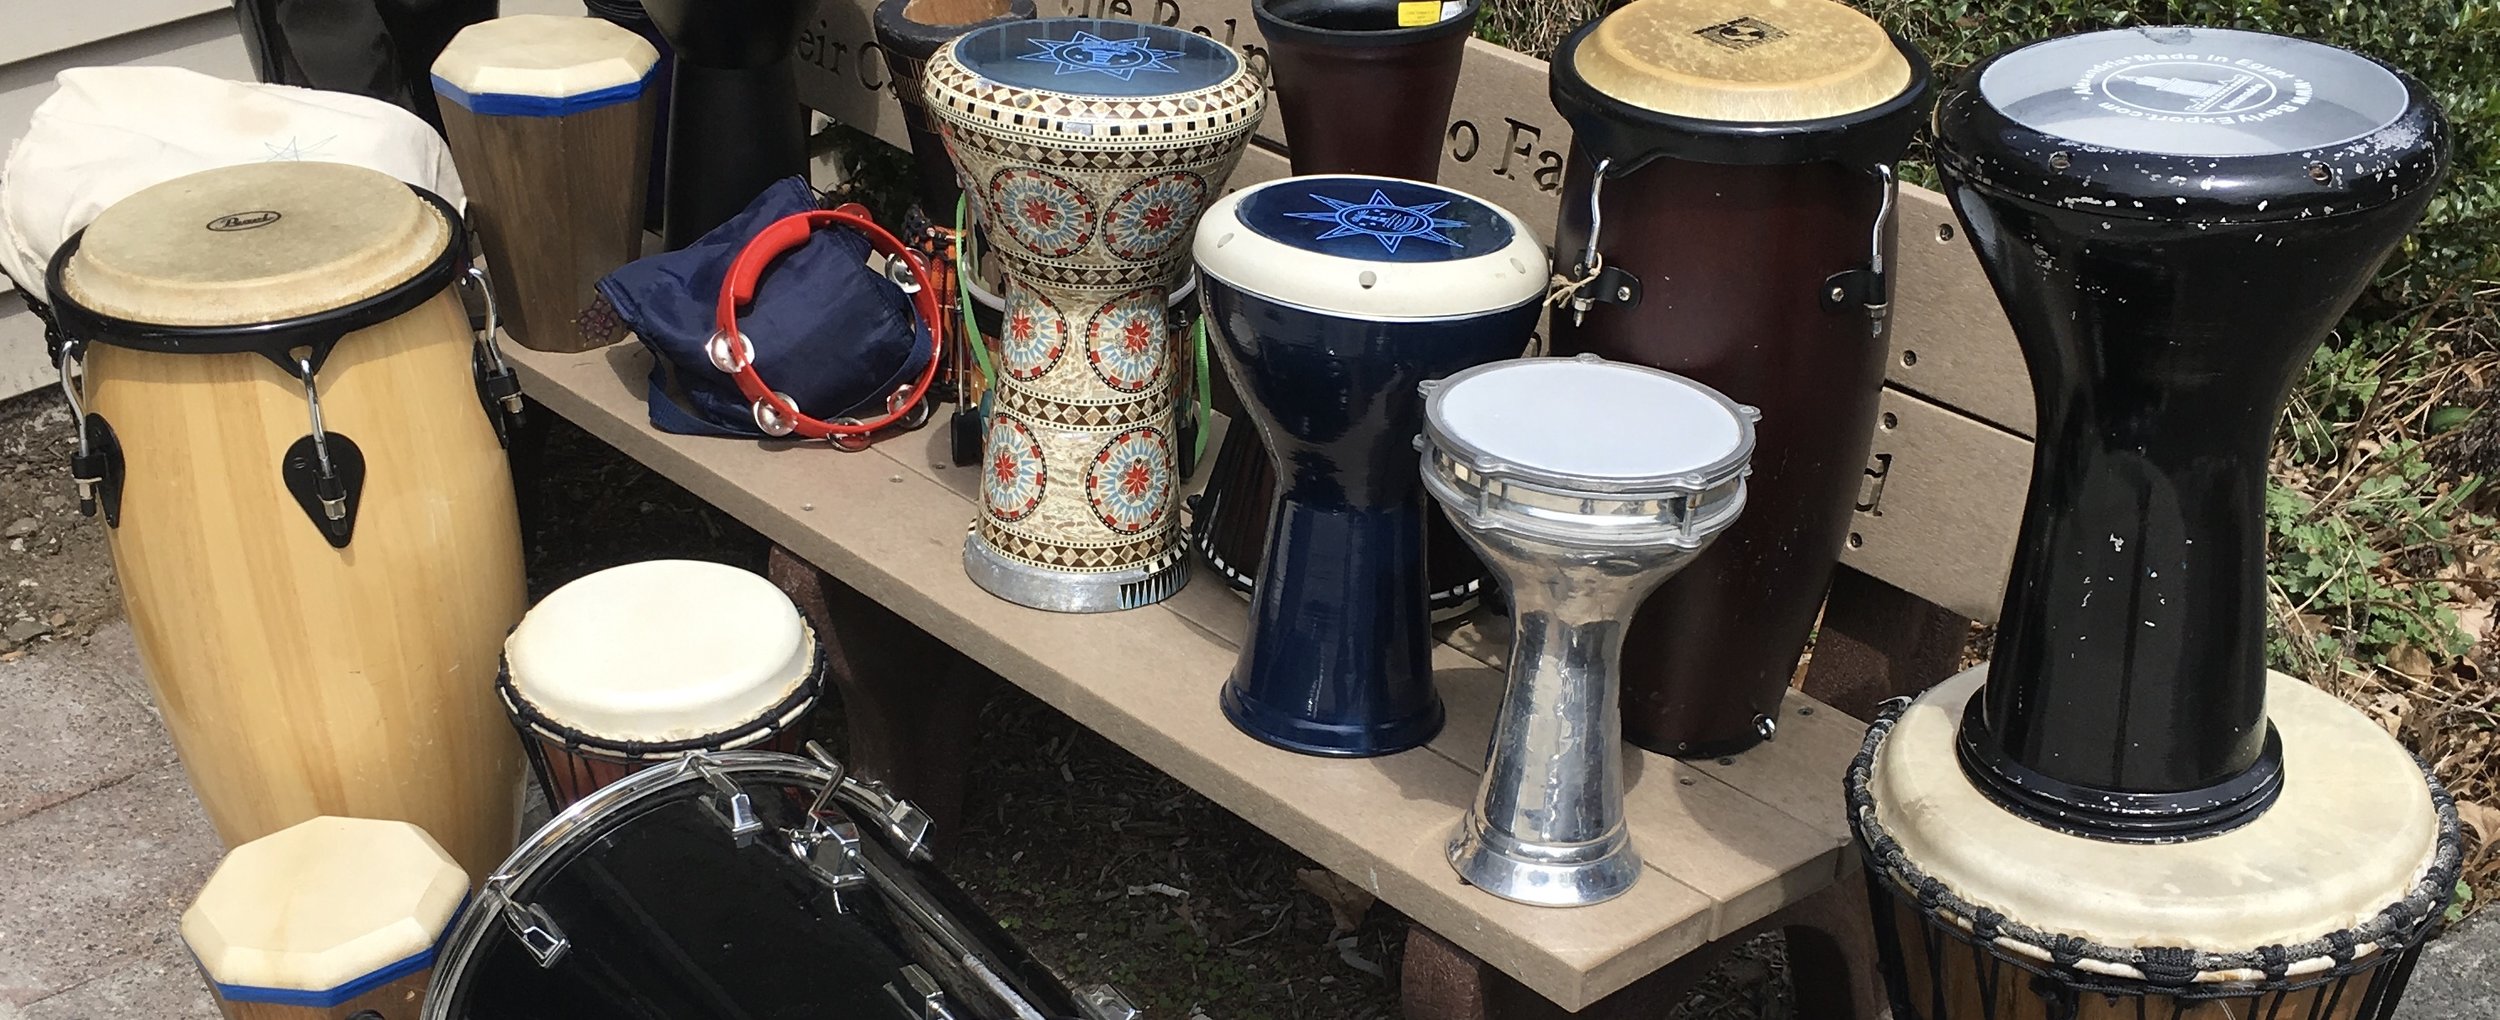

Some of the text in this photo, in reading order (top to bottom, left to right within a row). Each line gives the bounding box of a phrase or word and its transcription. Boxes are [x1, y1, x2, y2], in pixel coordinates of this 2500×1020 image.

[798, 19, 899, 100] eir C
[2133, 53, 2199, 61] Made
[2235, 58, 2295, 79] Egypt
[1446, 117, 1563, 196] o Fa
[219, 213, 275, 228] Pearl
[1855, 453, 1892, 517] d
